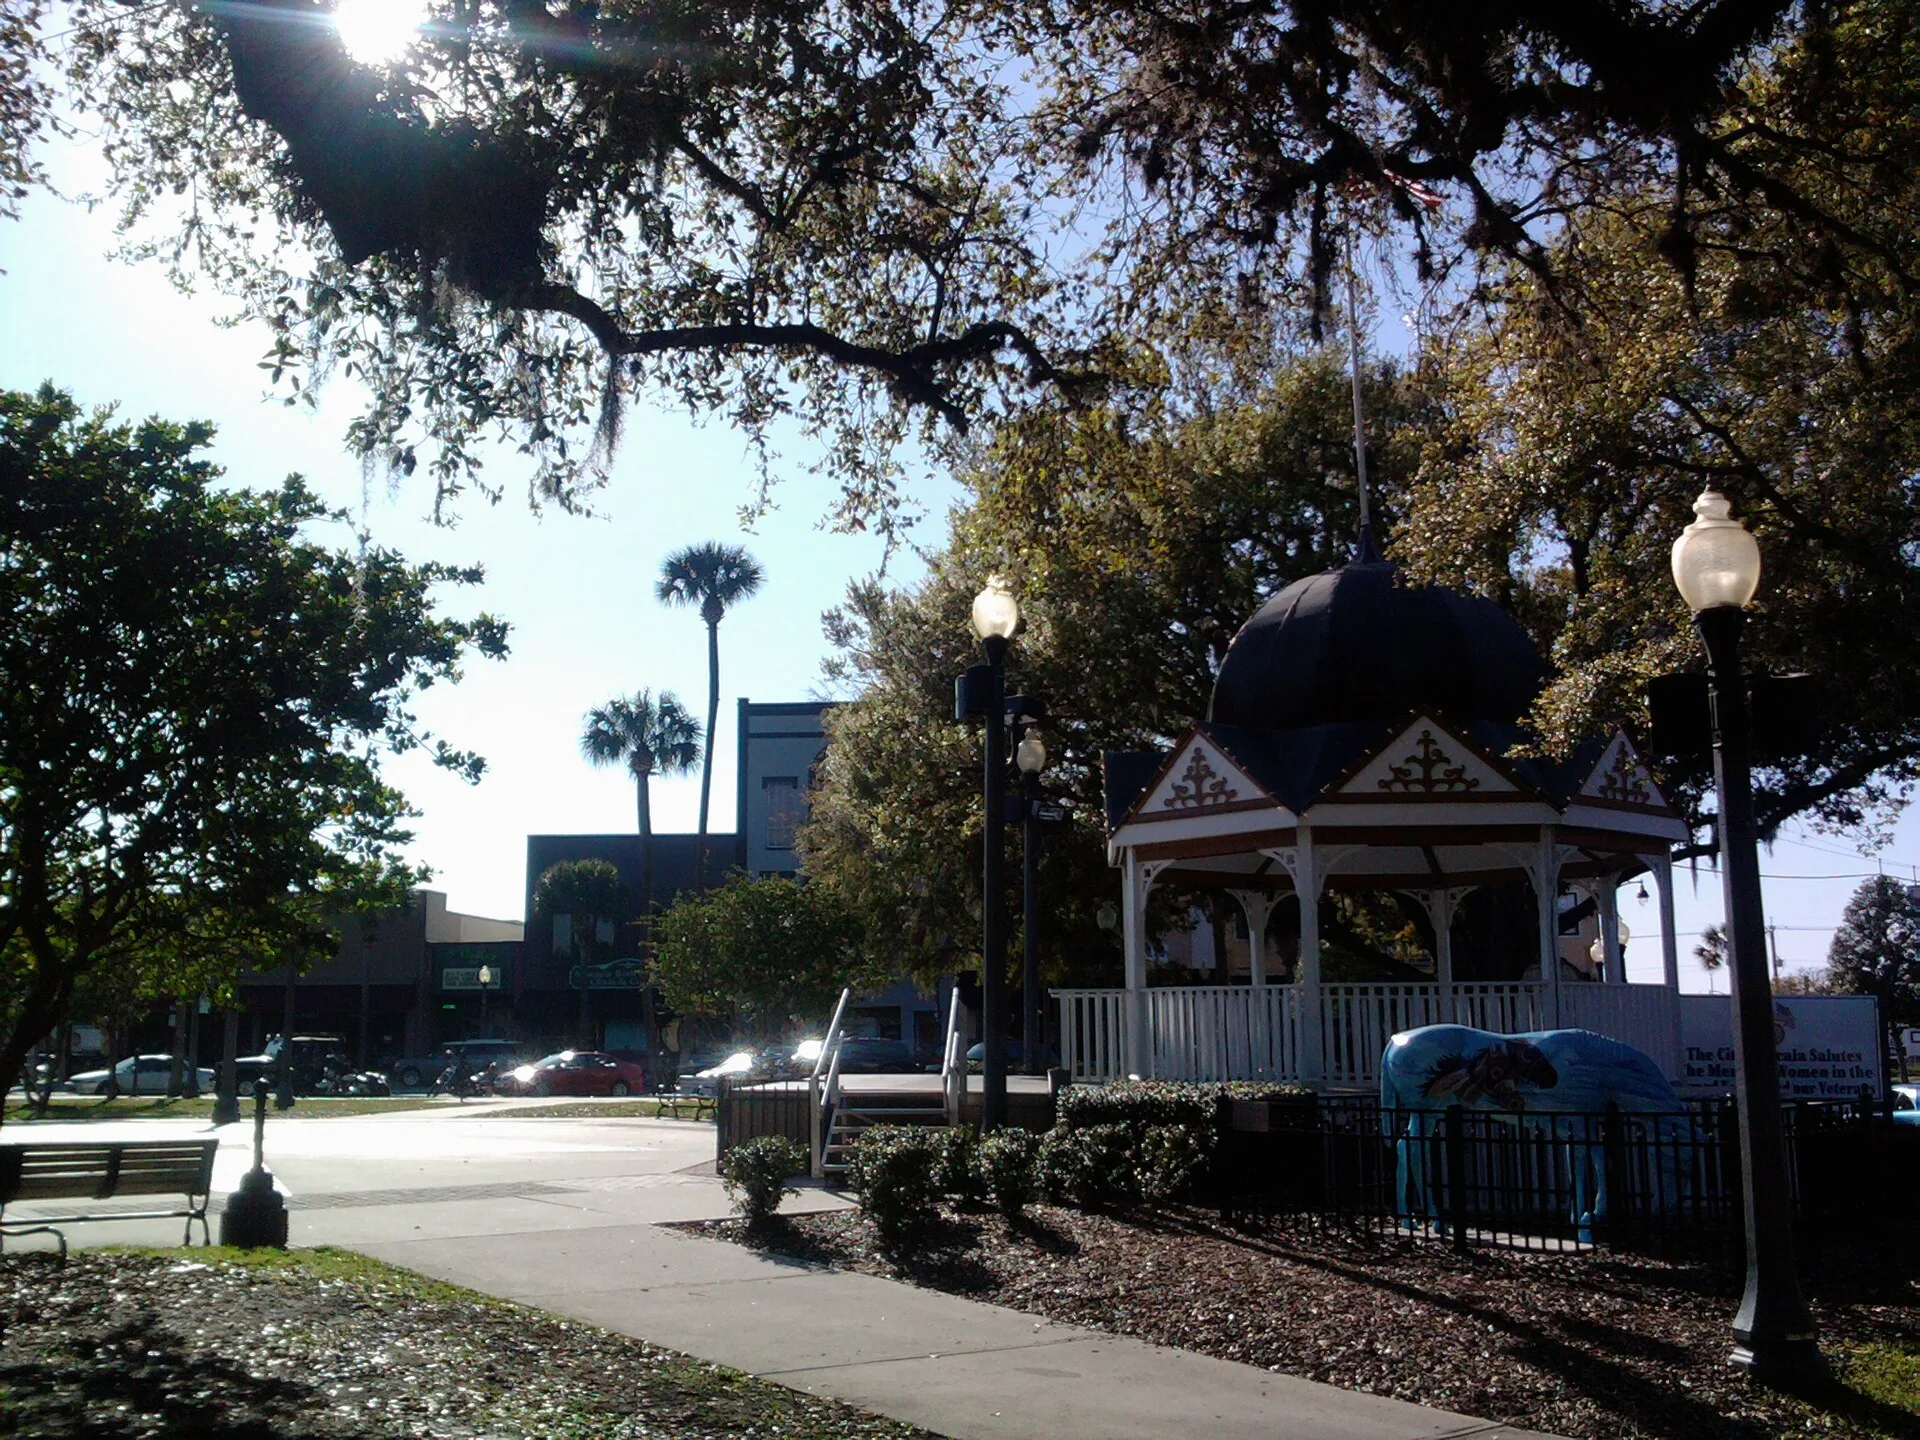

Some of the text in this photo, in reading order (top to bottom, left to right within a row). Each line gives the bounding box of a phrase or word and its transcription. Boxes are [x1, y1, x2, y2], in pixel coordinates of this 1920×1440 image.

[1685, 1047, 1713, 1061] The
[1776, 1049, 1806, 1061] cala
[1809, 1048, 1862, 1062] Salutes
[1832, 1065, 1846, 1078] in
[1850, 1065, 1873, 1078] the
[1793, 1084, 1816, 1094] our
[1818, 1081, 1876, 1095] Veteras
